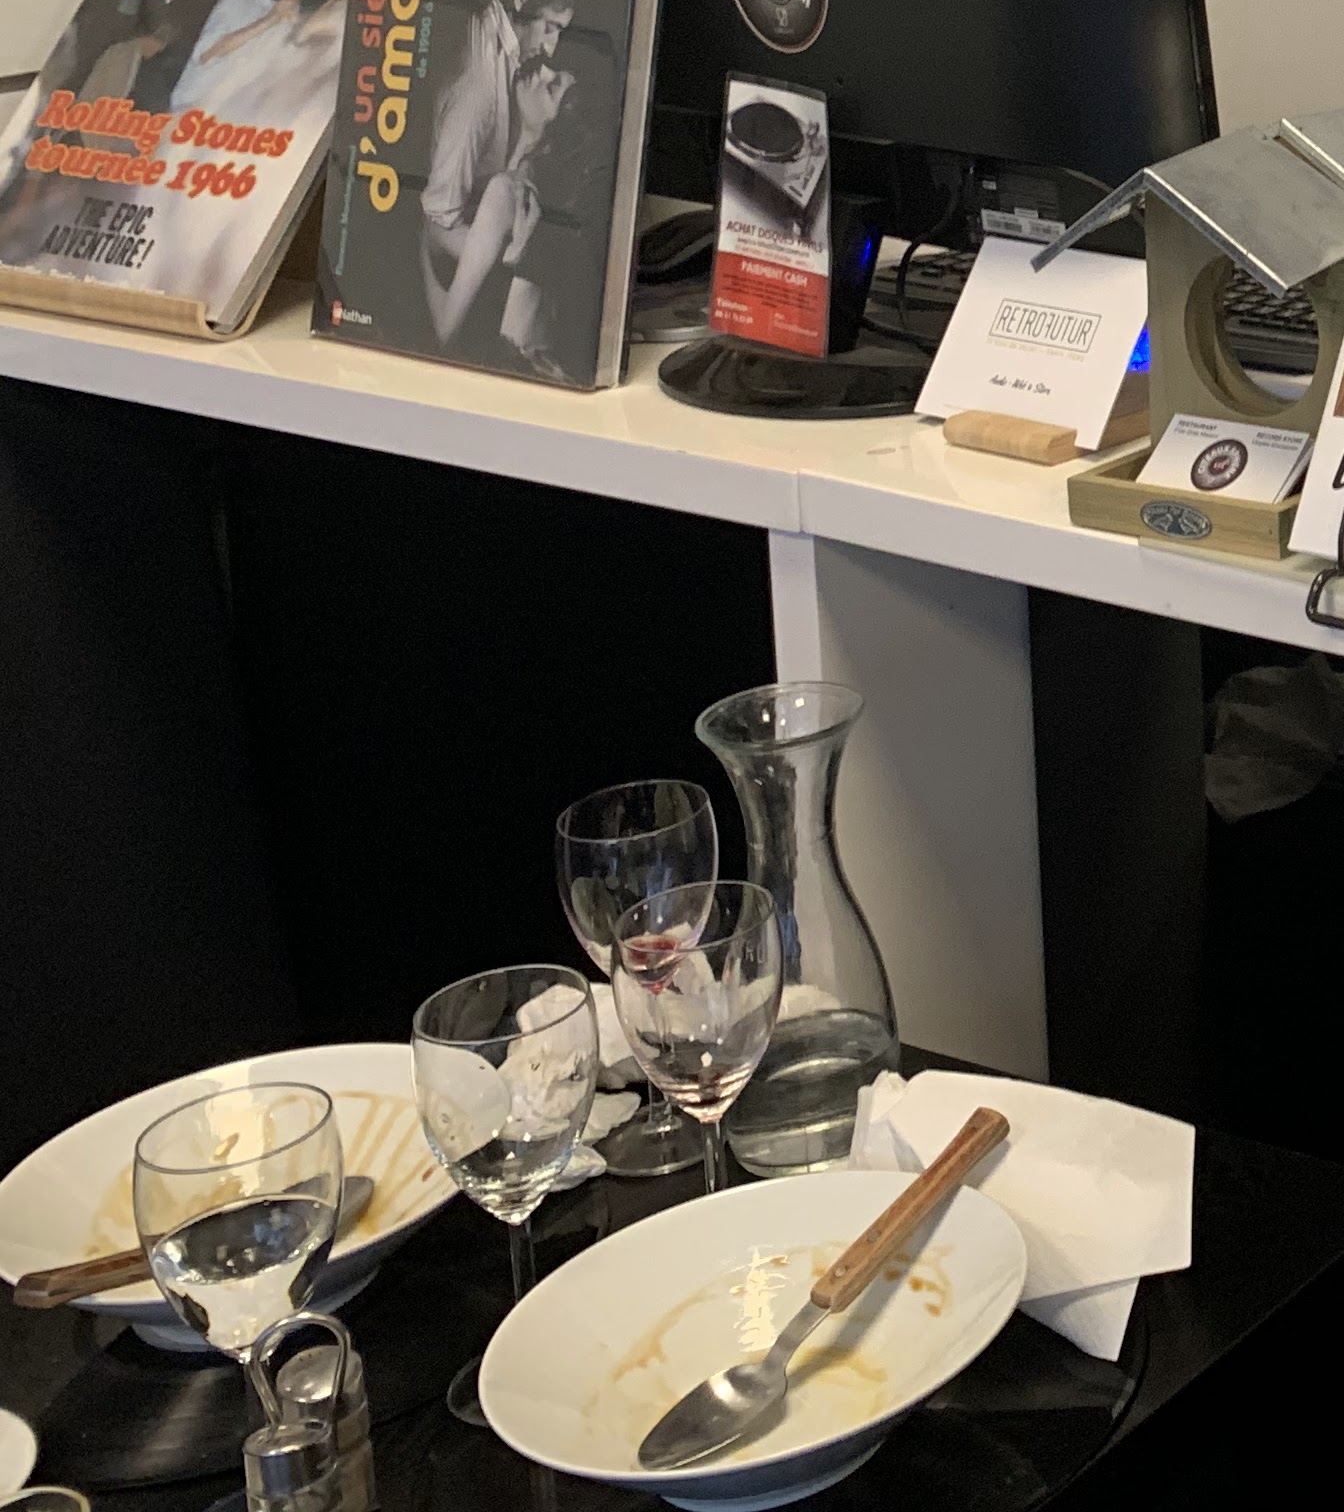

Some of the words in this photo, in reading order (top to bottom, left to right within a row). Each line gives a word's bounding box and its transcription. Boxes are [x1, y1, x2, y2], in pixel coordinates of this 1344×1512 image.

[353, 67, 377, 124] un
[38, 90, 170, 150] Rolling
[171, 108, 294, 158] Stones
[26, 136, 167, 186] tournée
[167, 158, 257, 200] 1966
[74, 196, 111, 228] THE
[111, 202, 153, 232] EPIC
[41, 222, 155, 268] ADVENTURE!
[996, 304, 1093, 346] RETROFUTUR
